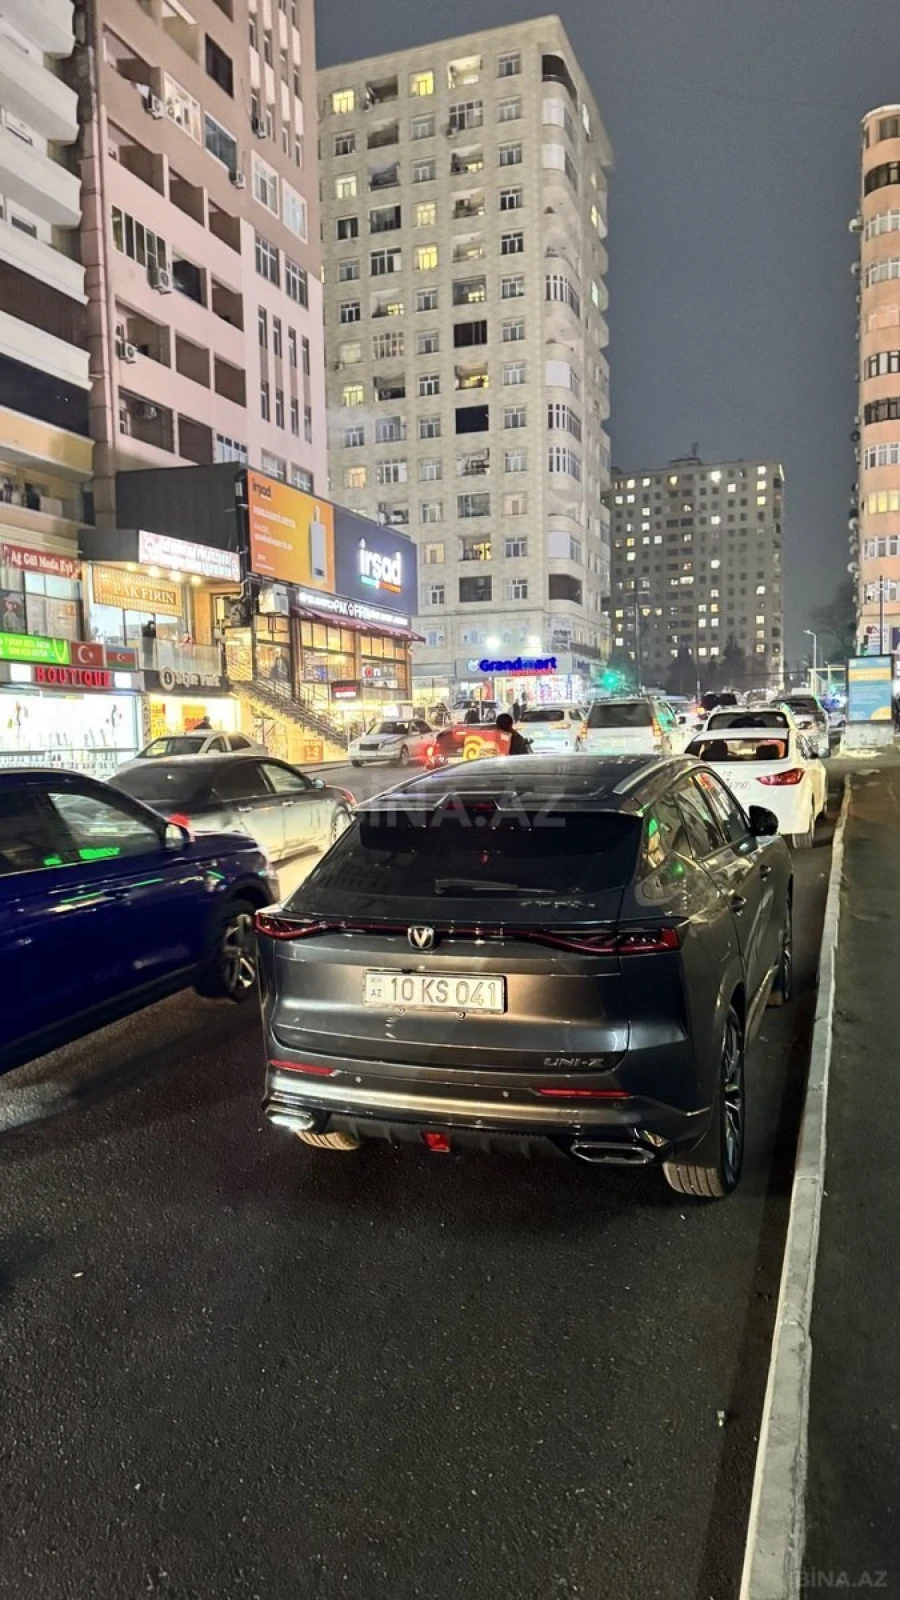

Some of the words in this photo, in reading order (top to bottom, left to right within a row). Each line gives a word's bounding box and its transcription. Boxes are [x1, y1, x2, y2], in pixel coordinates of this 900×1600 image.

[39, 556, 60, 571] Moda
[114, 581, 140, 598] PAK
[141, 587, 175, 602] FIRIN
[36, 667, 111, 687] BOUTIQUE
[391, 977, 414, 1001] 10
[421, 979, 449, 1004] KS
[455, 980, 496, 1007] 041
[543, 1057, 604, 1067] UNI-Z
